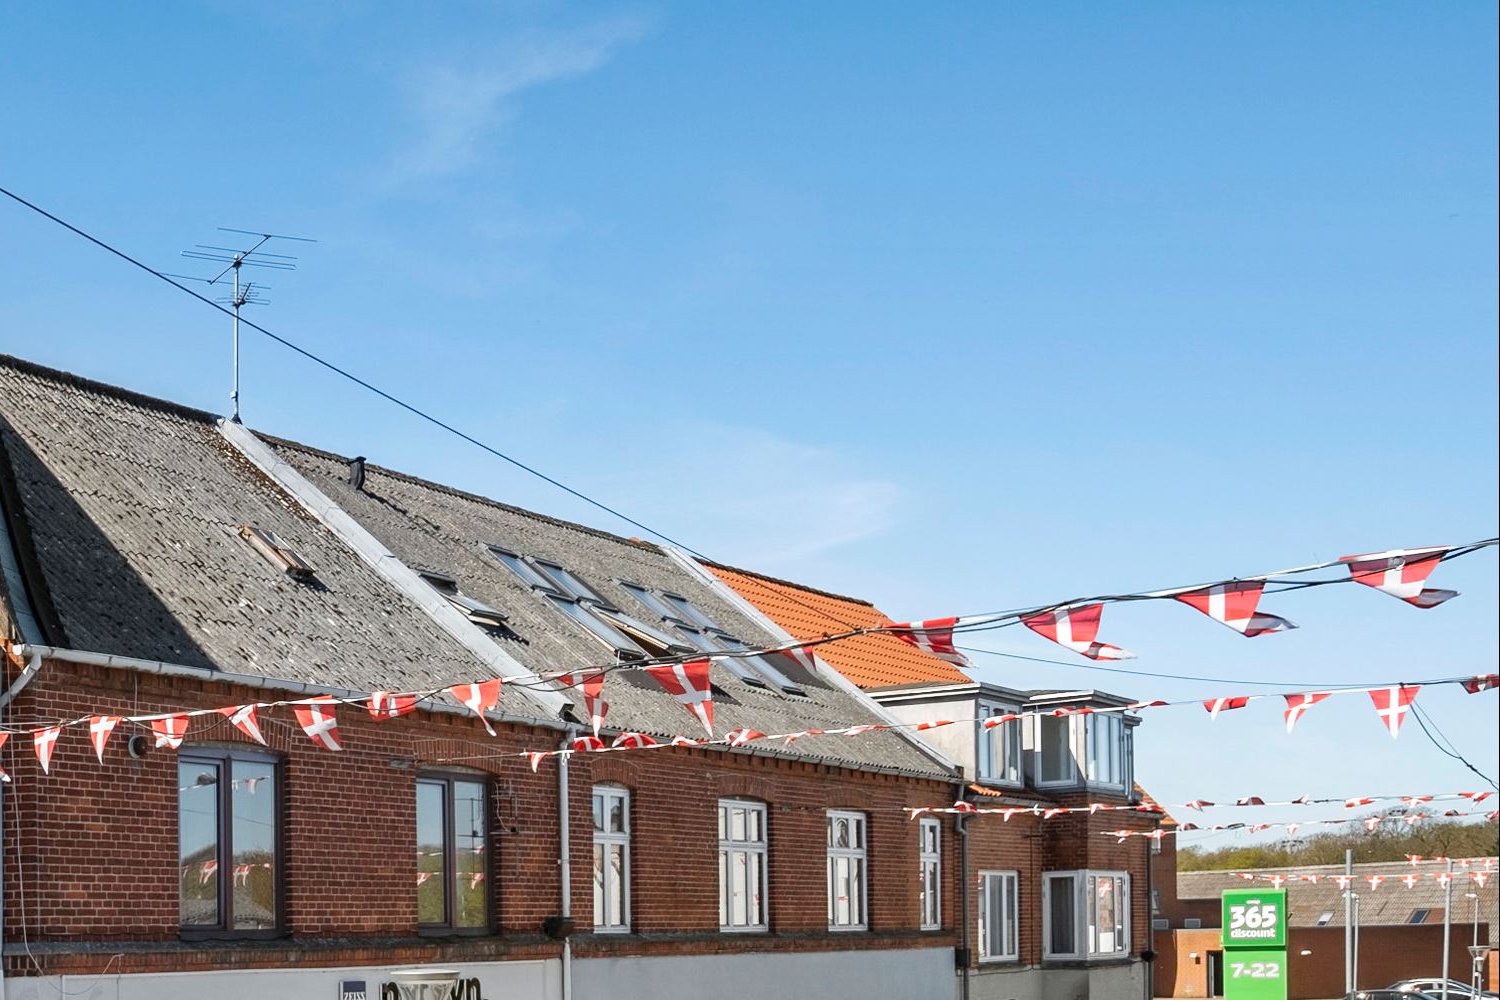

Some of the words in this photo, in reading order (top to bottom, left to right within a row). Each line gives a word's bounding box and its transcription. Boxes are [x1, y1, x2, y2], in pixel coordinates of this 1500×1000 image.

[1230, 904, 1277, 929] 365
[1230, 928, 1276, 938] discount
[1230, 962, 1280, 978] 7-22
